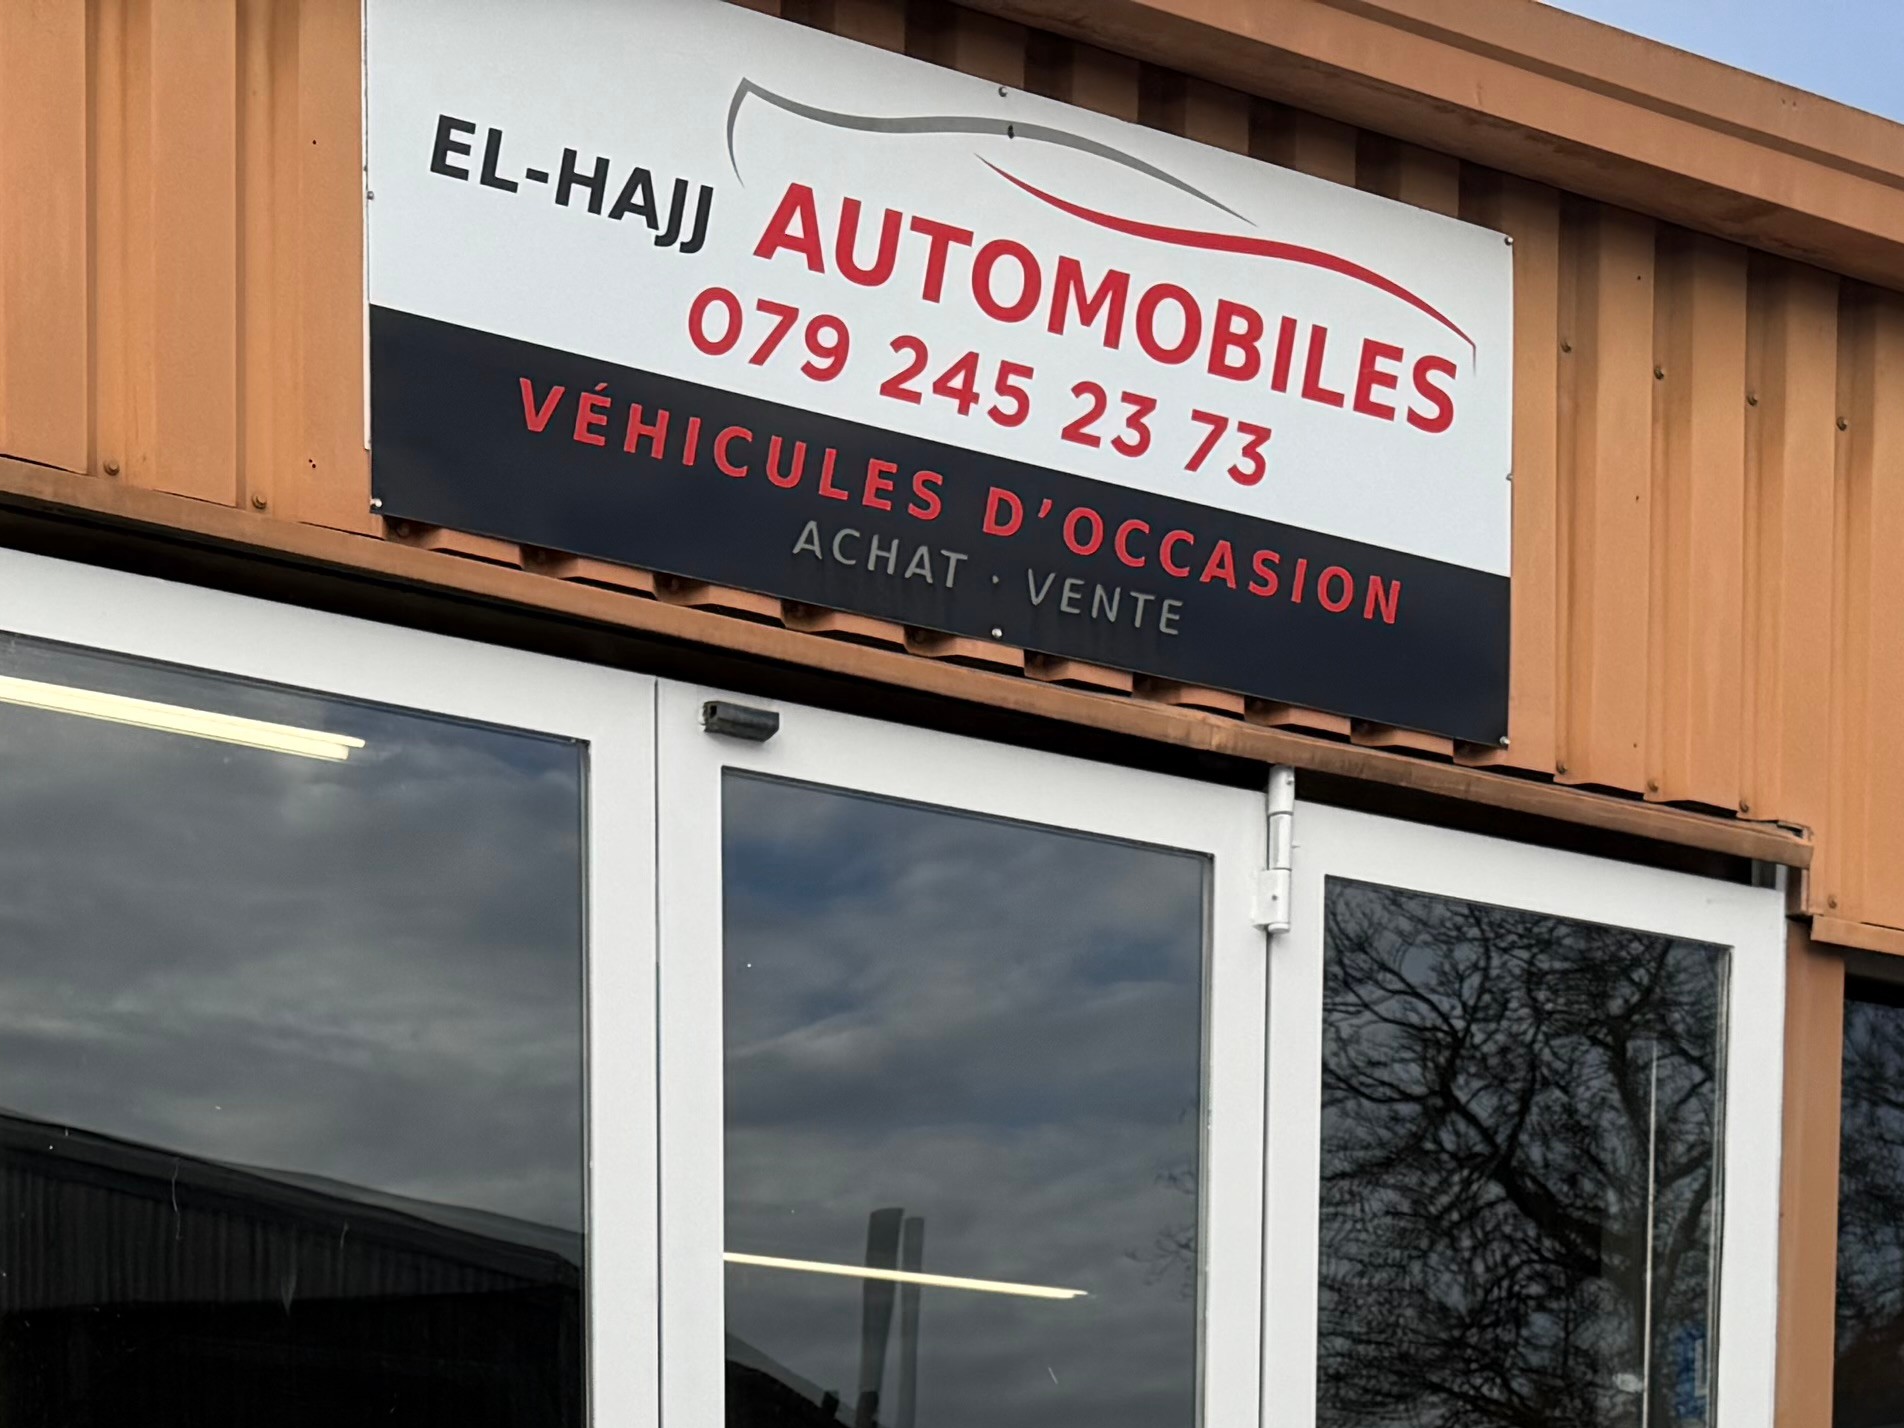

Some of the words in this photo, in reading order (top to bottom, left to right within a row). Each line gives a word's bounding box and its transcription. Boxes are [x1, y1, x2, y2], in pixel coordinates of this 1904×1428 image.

[430, 114, 714, 254] EL-HAJJ
[755, 182, 1457, 434] AUTOMOBILES
[688, 286, 850, 382] 079
[880, 335, 1034, 427] 245
[1062, 381, 1157, 458] 23
[1186, 409, 1272, 486] 73
[518, 377, 944, 521] VÉHICULES
[983, 487, 1402, 625] D'OCCASION
[792, 520, 969, 589] ACHAT
[1027, 568, 1184, 636] VENTE
